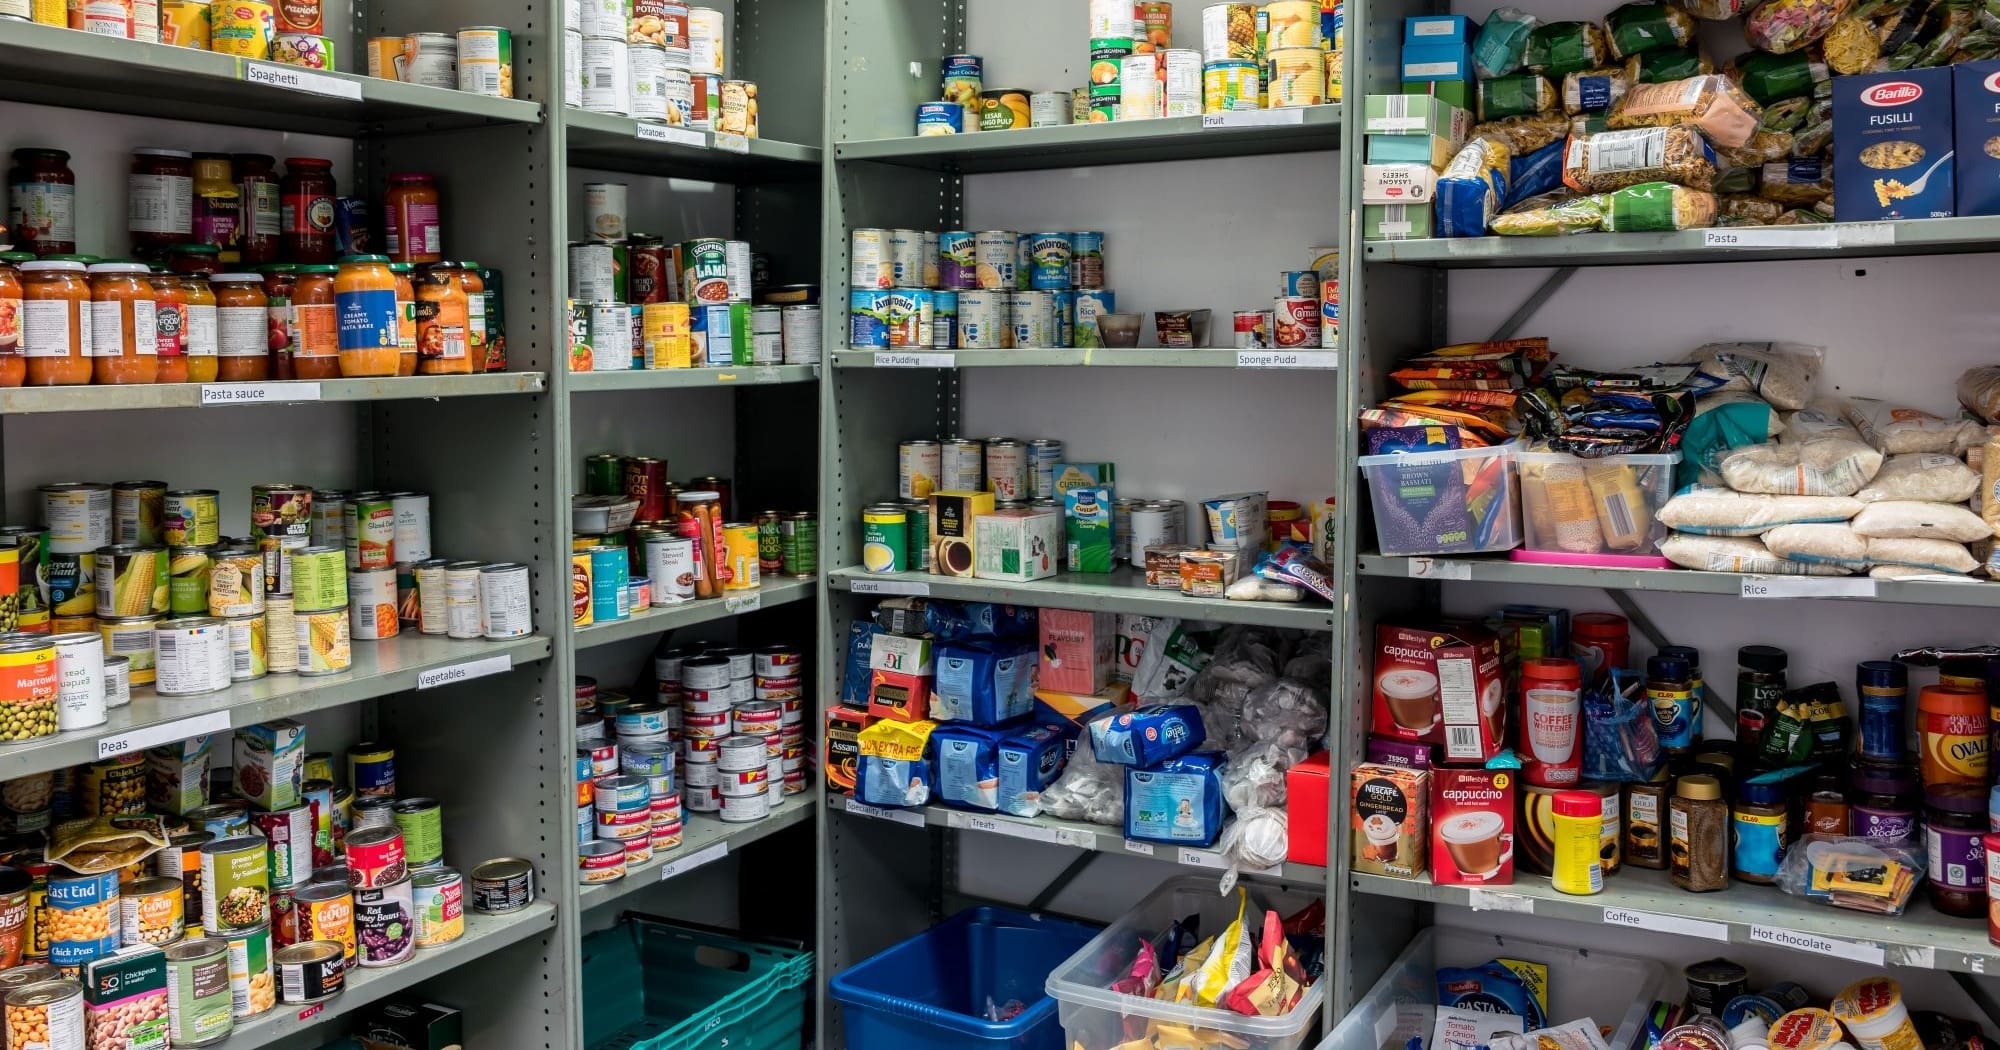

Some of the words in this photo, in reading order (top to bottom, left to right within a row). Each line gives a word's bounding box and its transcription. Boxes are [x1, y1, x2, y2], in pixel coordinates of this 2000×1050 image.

[250, 67, 298, 85] Spaghetti
[1874, 86, 1917, 100] Barilla
[1204, 116, 1224, 125] Fruit
[1870, 112, 1913, 126] FUSILLI
[638, 126, 666, 138] Potatoes
[1708, 232, 1737, 244] Pasta
[696, 264, 726, 278] LAMB
[876, 356, 890, 364] Rice
[892, 355, 920, 365] Pudding
[1240, 356, 1272, 365] Sponge
[1274, 356, 1297, 364] Pudd
[204, 389, 232, 400] Pasta
[234, 390, 264, 399] sauce
[762, 536, 779, 545] HOT
[852, 582, 878, 591] Custard
[1744, 585, 1768, 595] Rice
[1384, 644, 1434, 660] cappuccin
[419, 668, 466, 688] Vegetables
[32, 686, 52, 696] Peas
[1534, 712, 1573, 724] COFFEE
[1534, 722, 1572, 733] WHITENER
[100, 739, 128, 754] Peas
[832, 741, 858, 752] Assam
[1466, 775, 1489, 783] lifestyle
[1496, 777, 1507, 785] £1
[1371, 793, 1393, 802] GOLD
[1442, 788, 1502, 800] cappuccino
[846, 802, 880, 818] Speciality
[880, 808, 894, 818] Tea
[1360, 802, 1404, 813] GINGERBREAD
[972, 818, 995, 830] Treats
[1185, 854, 1201, 864] Tea
[72, 883, 95, 896] End
[367, 906, 382, 915] Red
[377, 910, 400, 921] Beans
[1605, 910, 1640, 925] Coffee
[1752, 927, 1774, 939] Hot
[1776, 931, 1832, 951] chocolate
[52, 948, 72, 957] Chick
[74, 947, 94, 956] Peas
[124, 967, 157, 980] Chickpeas
[1458, 1002, 1496, 1014] PASTA
[1448, 1022, 1476, 1031] Tomato
[1453, 1030, 1476, 1040] Onion
